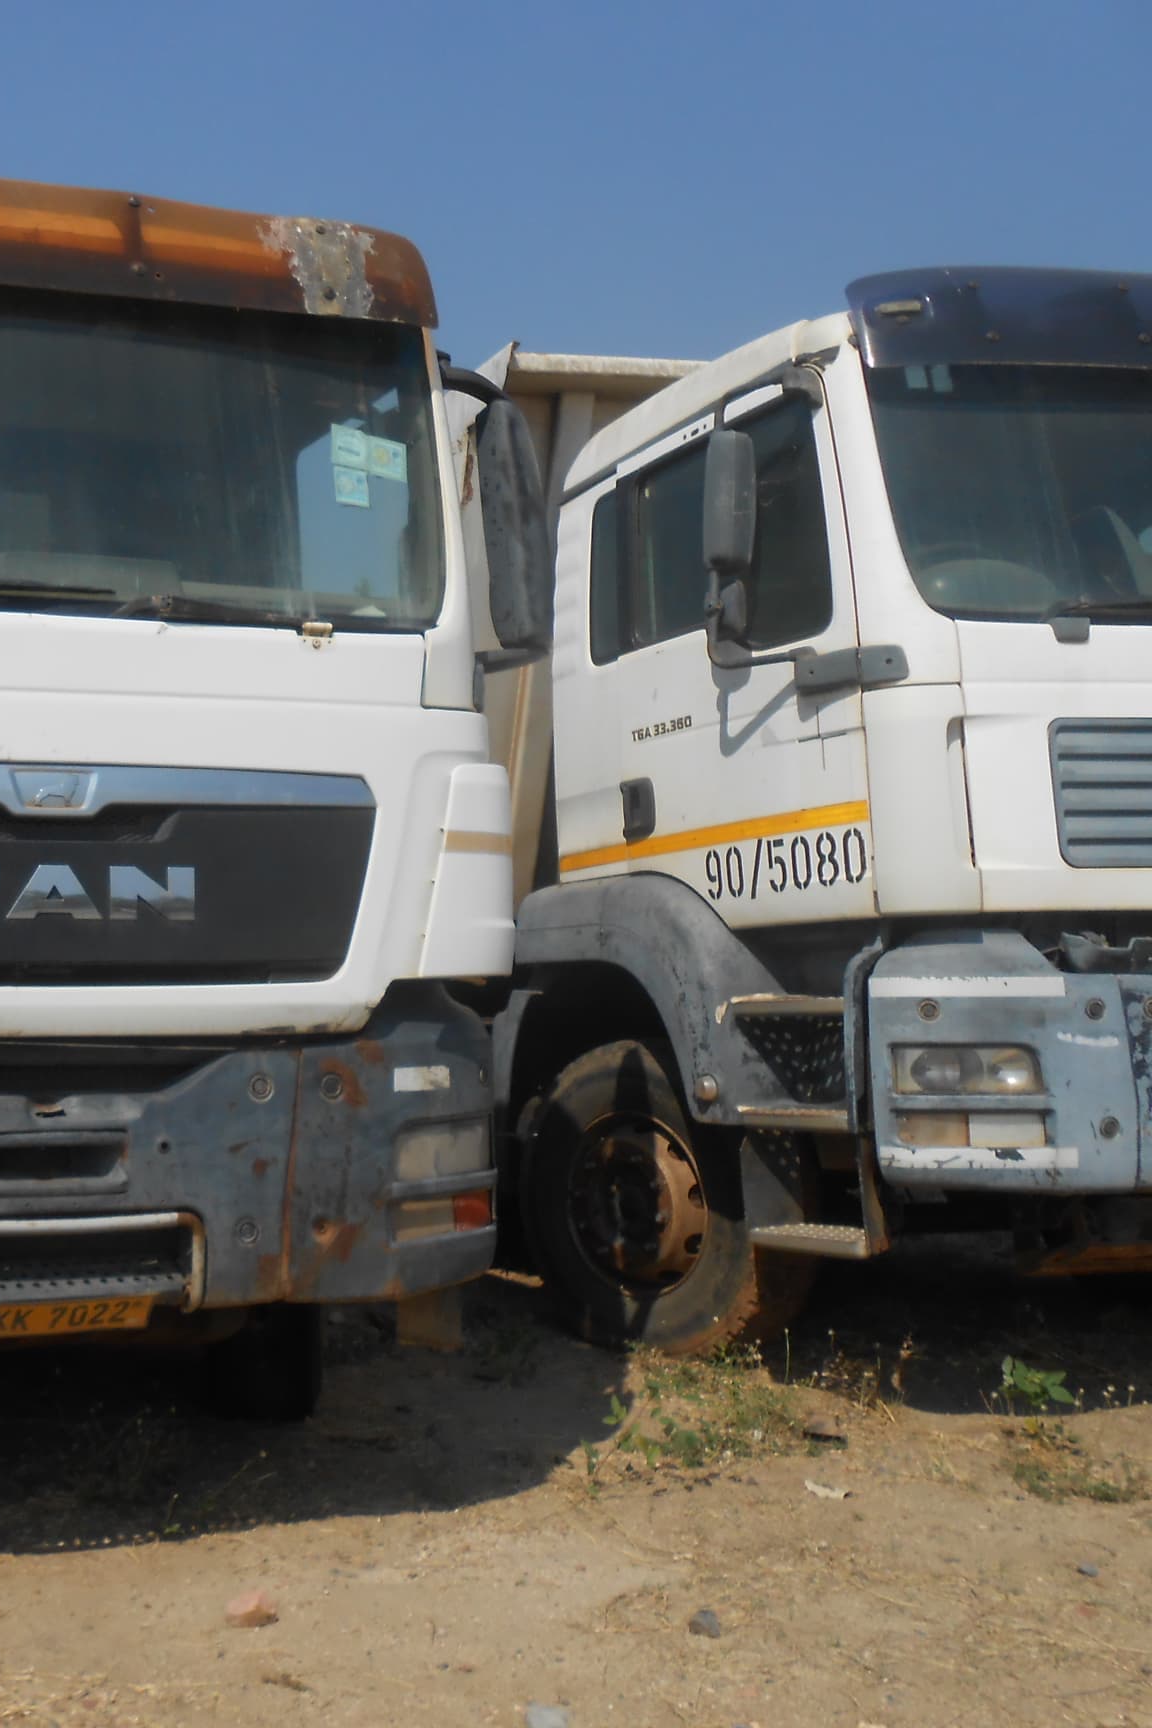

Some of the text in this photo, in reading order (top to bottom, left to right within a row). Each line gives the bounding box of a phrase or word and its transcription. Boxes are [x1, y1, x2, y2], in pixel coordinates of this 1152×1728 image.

[631, 727, 652, 742] TGA
[705, 827, 867, 900] 90/5080
[50, 1301, 131, 1329] 7022
